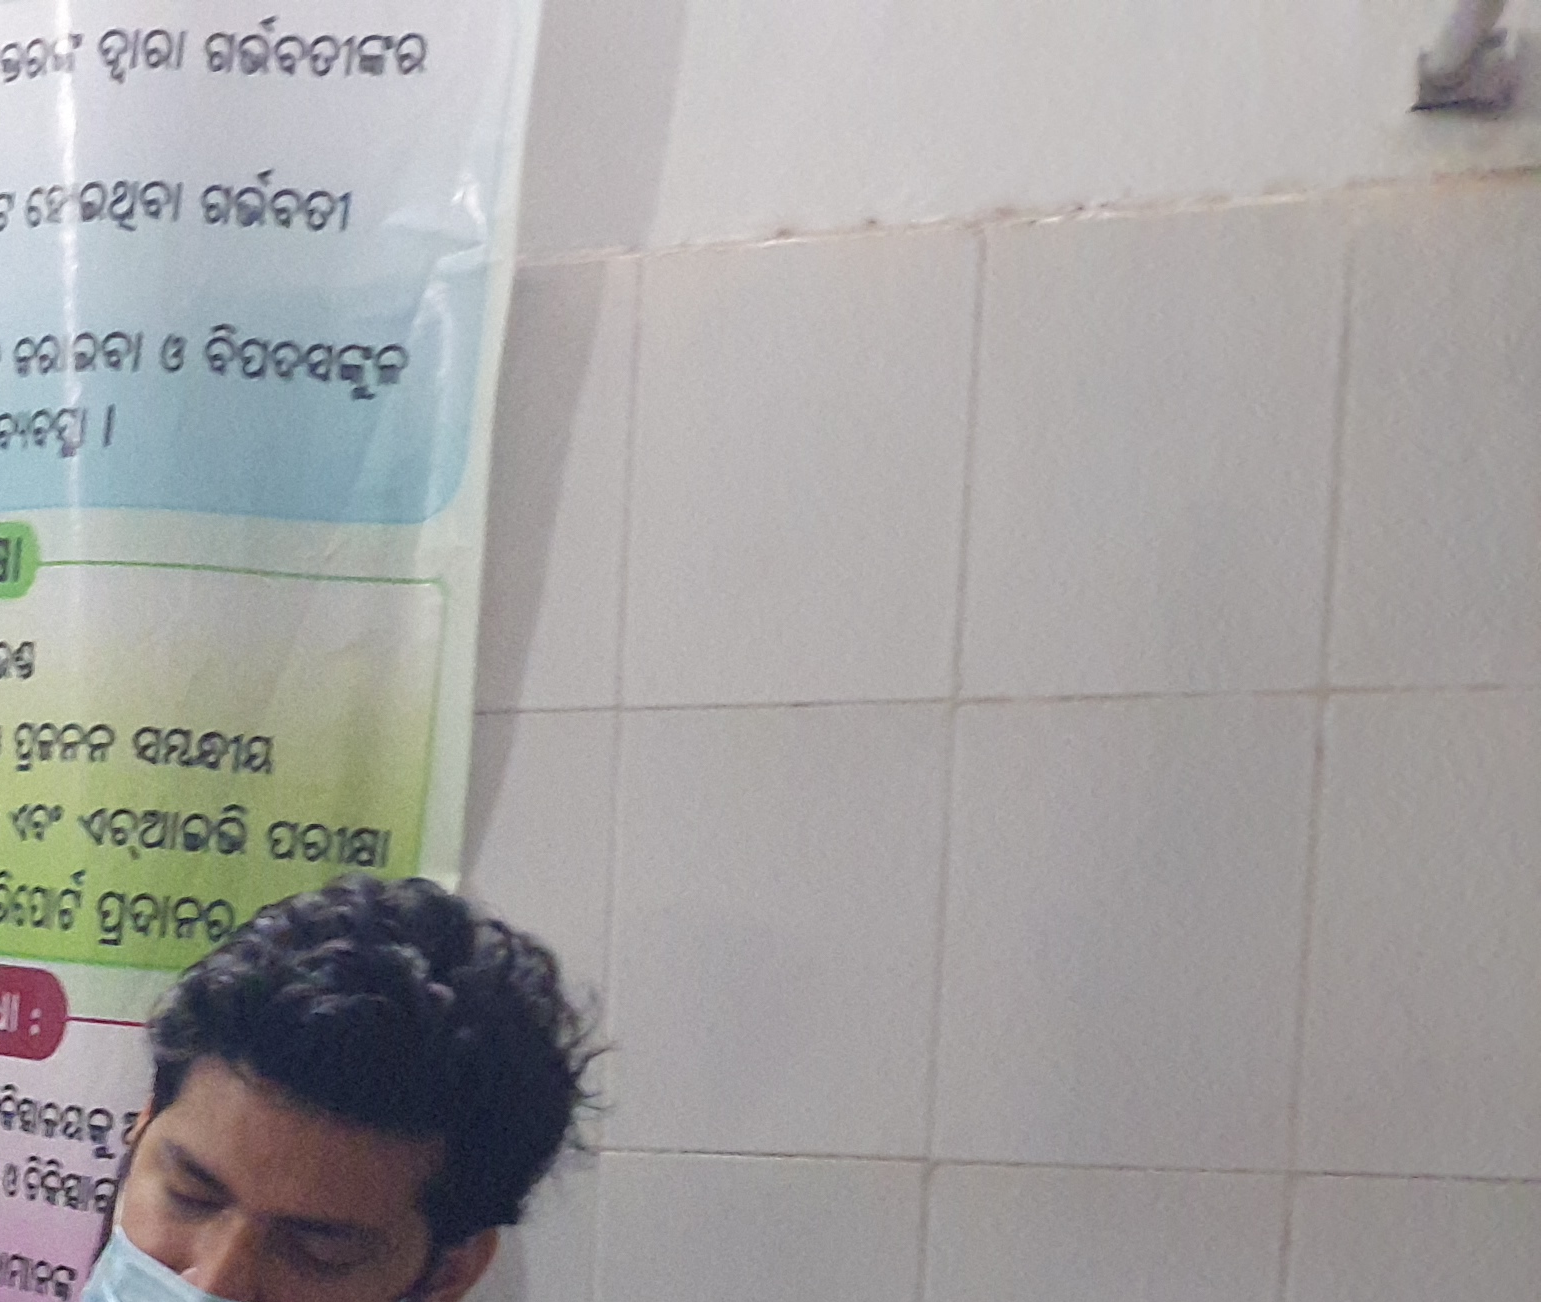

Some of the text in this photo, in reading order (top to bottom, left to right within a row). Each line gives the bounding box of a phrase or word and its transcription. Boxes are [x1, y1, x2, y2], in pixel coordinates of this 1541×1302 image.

[205, 16, 428, 78] ଗର୍ଭବତୀଙ୍କର
[201, 170, 352, 231] ଗର୍ଭବତୀ
[161, 335, 186, 373] ଓ
[265, 818, 392, 870] ପରୀକ୍ଷା
